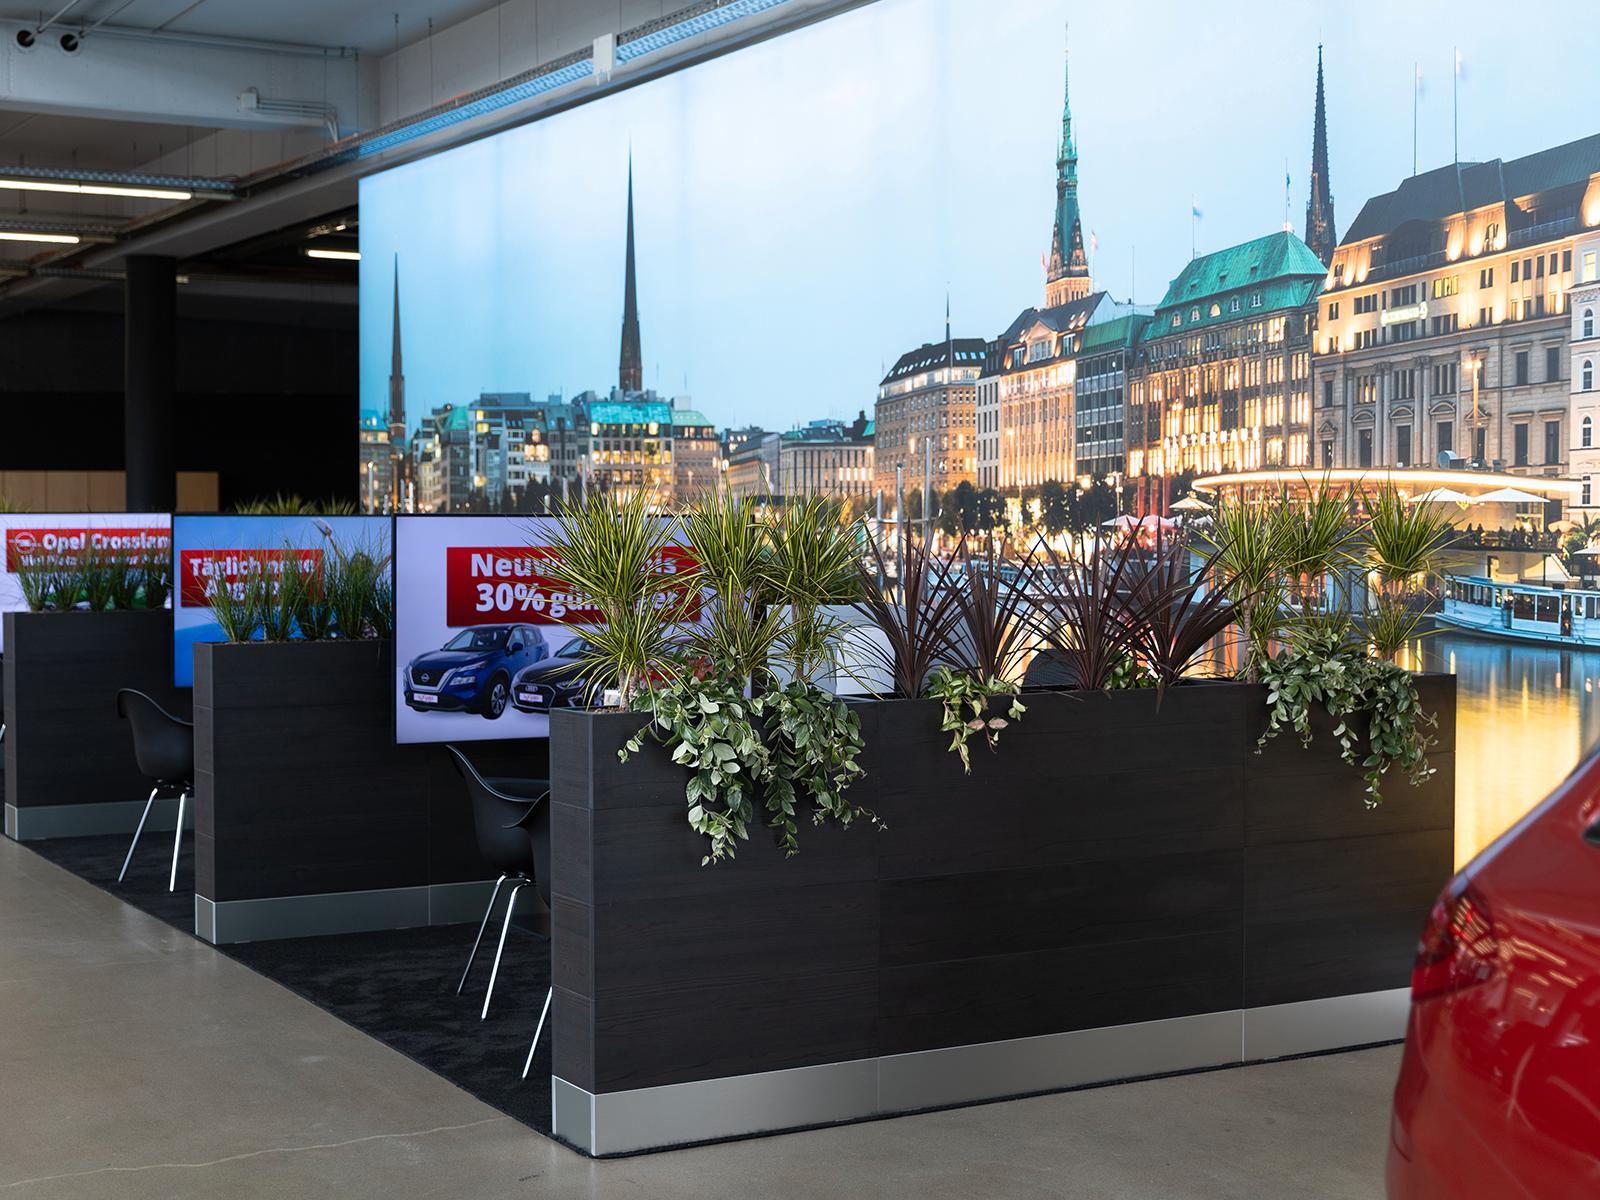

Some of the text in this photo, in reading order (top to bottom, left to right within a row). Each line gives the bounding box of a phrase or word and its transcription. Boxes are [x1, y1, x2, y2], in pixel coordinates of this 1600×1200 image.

[42, 532, 86, 554] Opel
[189, 556, 262, 581] Täglich
[475, 583, 545, 612] 30%
